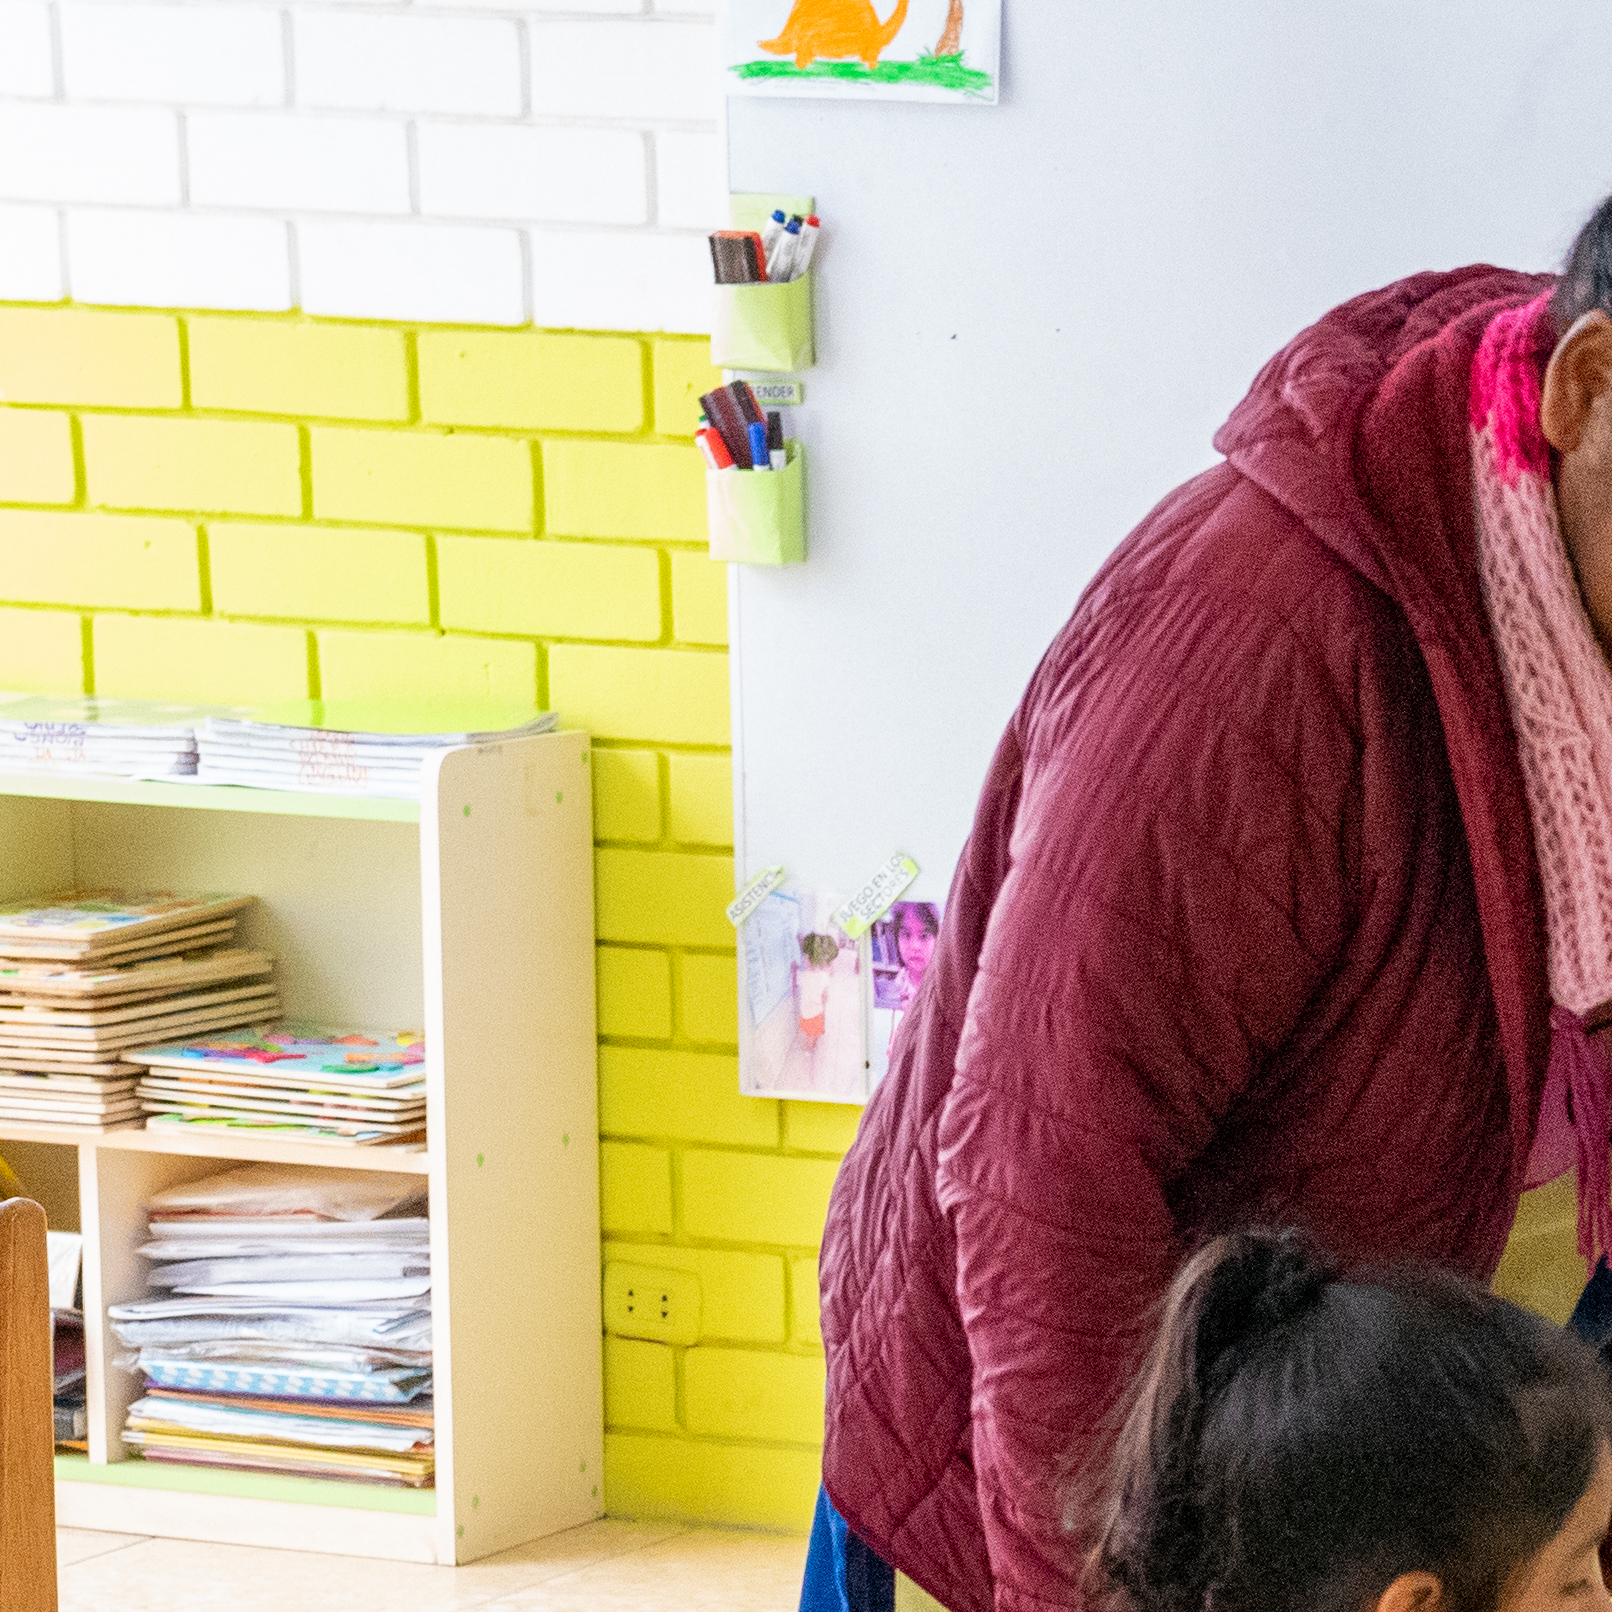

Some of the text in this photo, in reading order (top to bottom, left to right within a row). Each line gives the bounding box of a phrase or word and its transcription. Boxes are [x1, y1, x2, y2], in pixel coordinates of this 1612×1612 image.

[756, 385, 794, 399] ENDER
[730, 871, 777, 920] ASISTENC
[839, 885, 875, 923] JUEGO
[871, 873, 889, 890] EN
[860, 868, 909, 919] SECTORES
